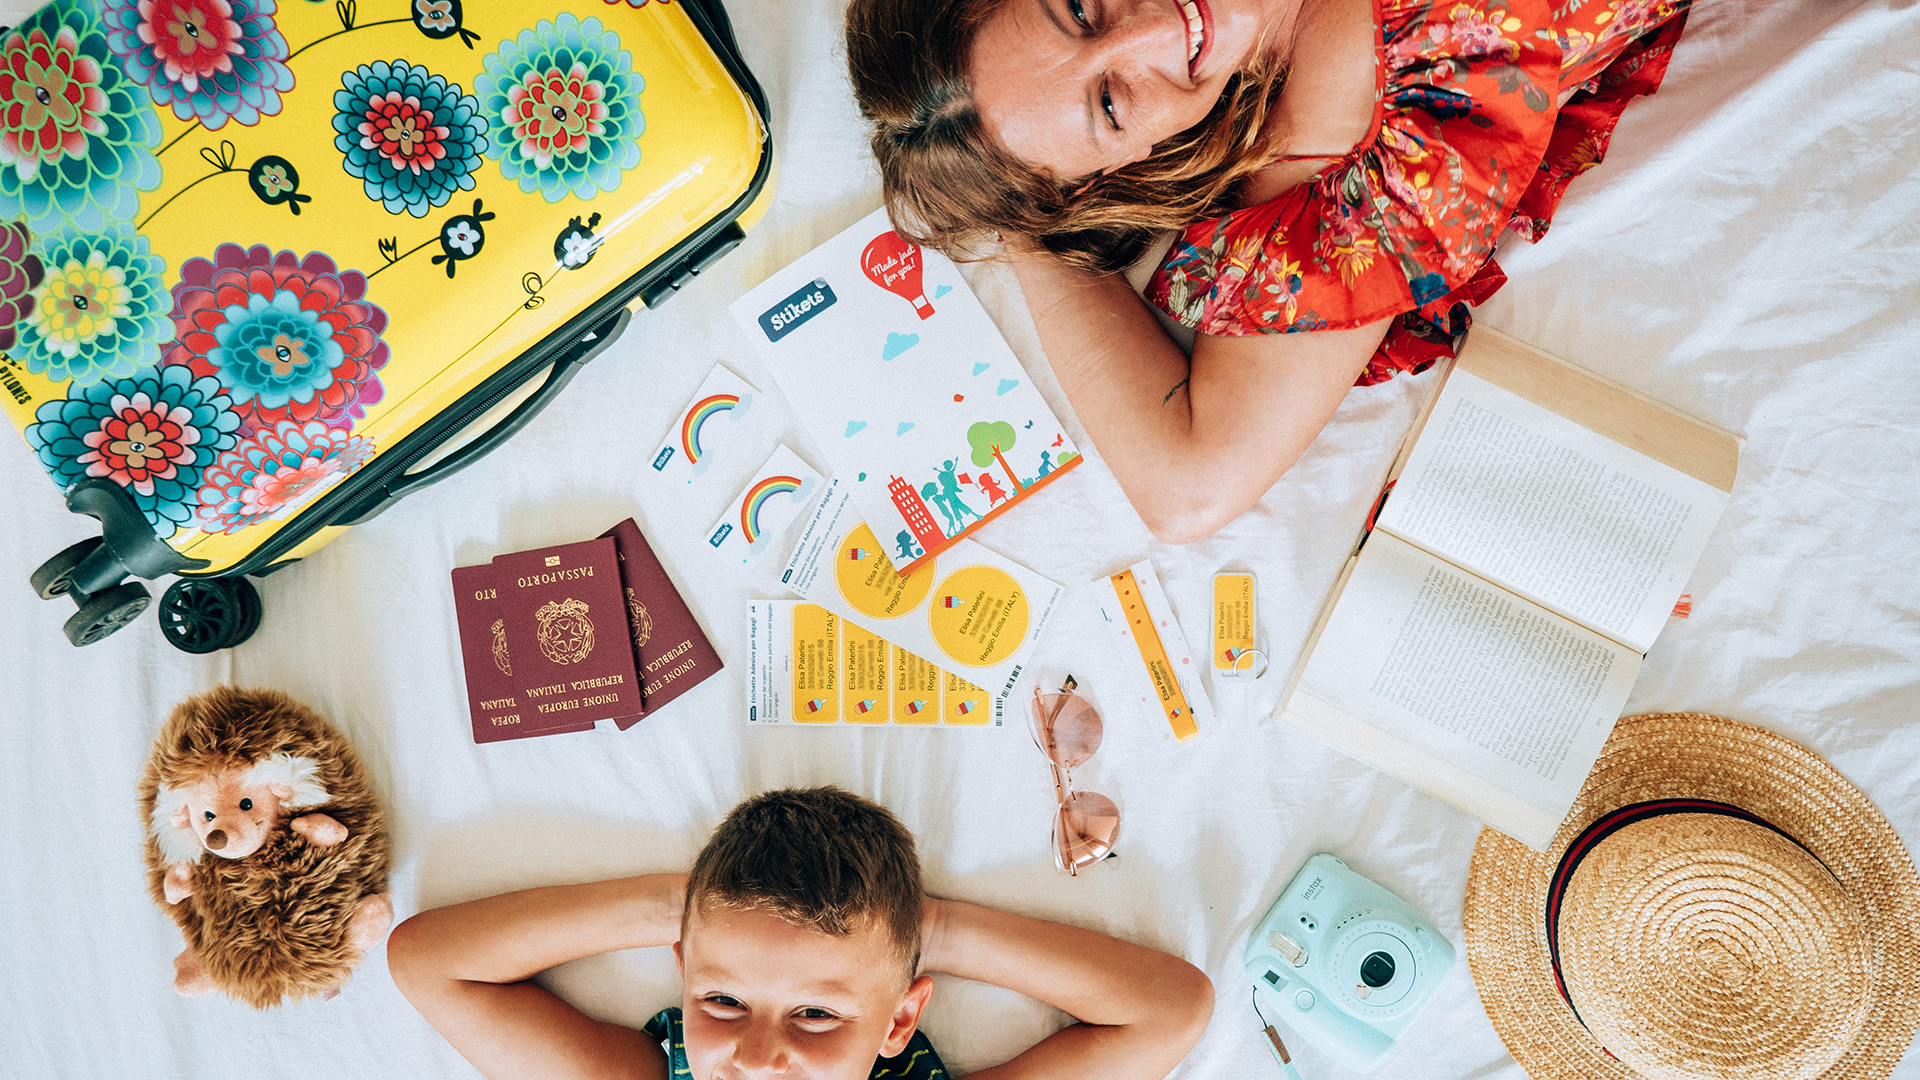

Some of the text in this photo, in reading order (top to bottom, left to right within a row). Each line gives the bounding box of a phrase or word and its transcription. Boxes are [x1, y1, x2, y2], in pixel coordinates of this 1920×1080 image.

[871, 244, 916, 276] Made just
[883, 258, 916, 286] for you!
[771, 291, 824, 331] Stikets
[790, 542, 805, 567] Etichette
[804, 520, 816, 541] Adesive
[518, 566, 594, 587] PASSAPORTO
[865, 570, 877, 586] Elisa
[874, 550, 886, 569] Pater
[475, 589, 497, 600] RTO
[885, 591, 901, 613] Reggio
[959, 618, 971, 634] Elisa
[968, 591, 985, 617] Paterlini
[980, 639, 995, 661] Reggio
[992, 618, 1006, 637] Emilia
[1003, 591, 1020, 617] (ITALY)
[647, 640, 693, 672] REPUBBLICA
[573, 674, 623, 690] REPUBBLICA
[666, 659, 695, 683] UNIONE
[526, 683, 566, 697] ITALIANA
[642, 679, 662, 697] EURO
[1160, 686, 1171, 701] Elisa
[481, 698, 516, 710] TALIANA
[538, 693, 619, 713] UNIONE EUROPEA
[491, 714, 520, 726] ROPEA
[1303, 877, 1323, 900] instax
